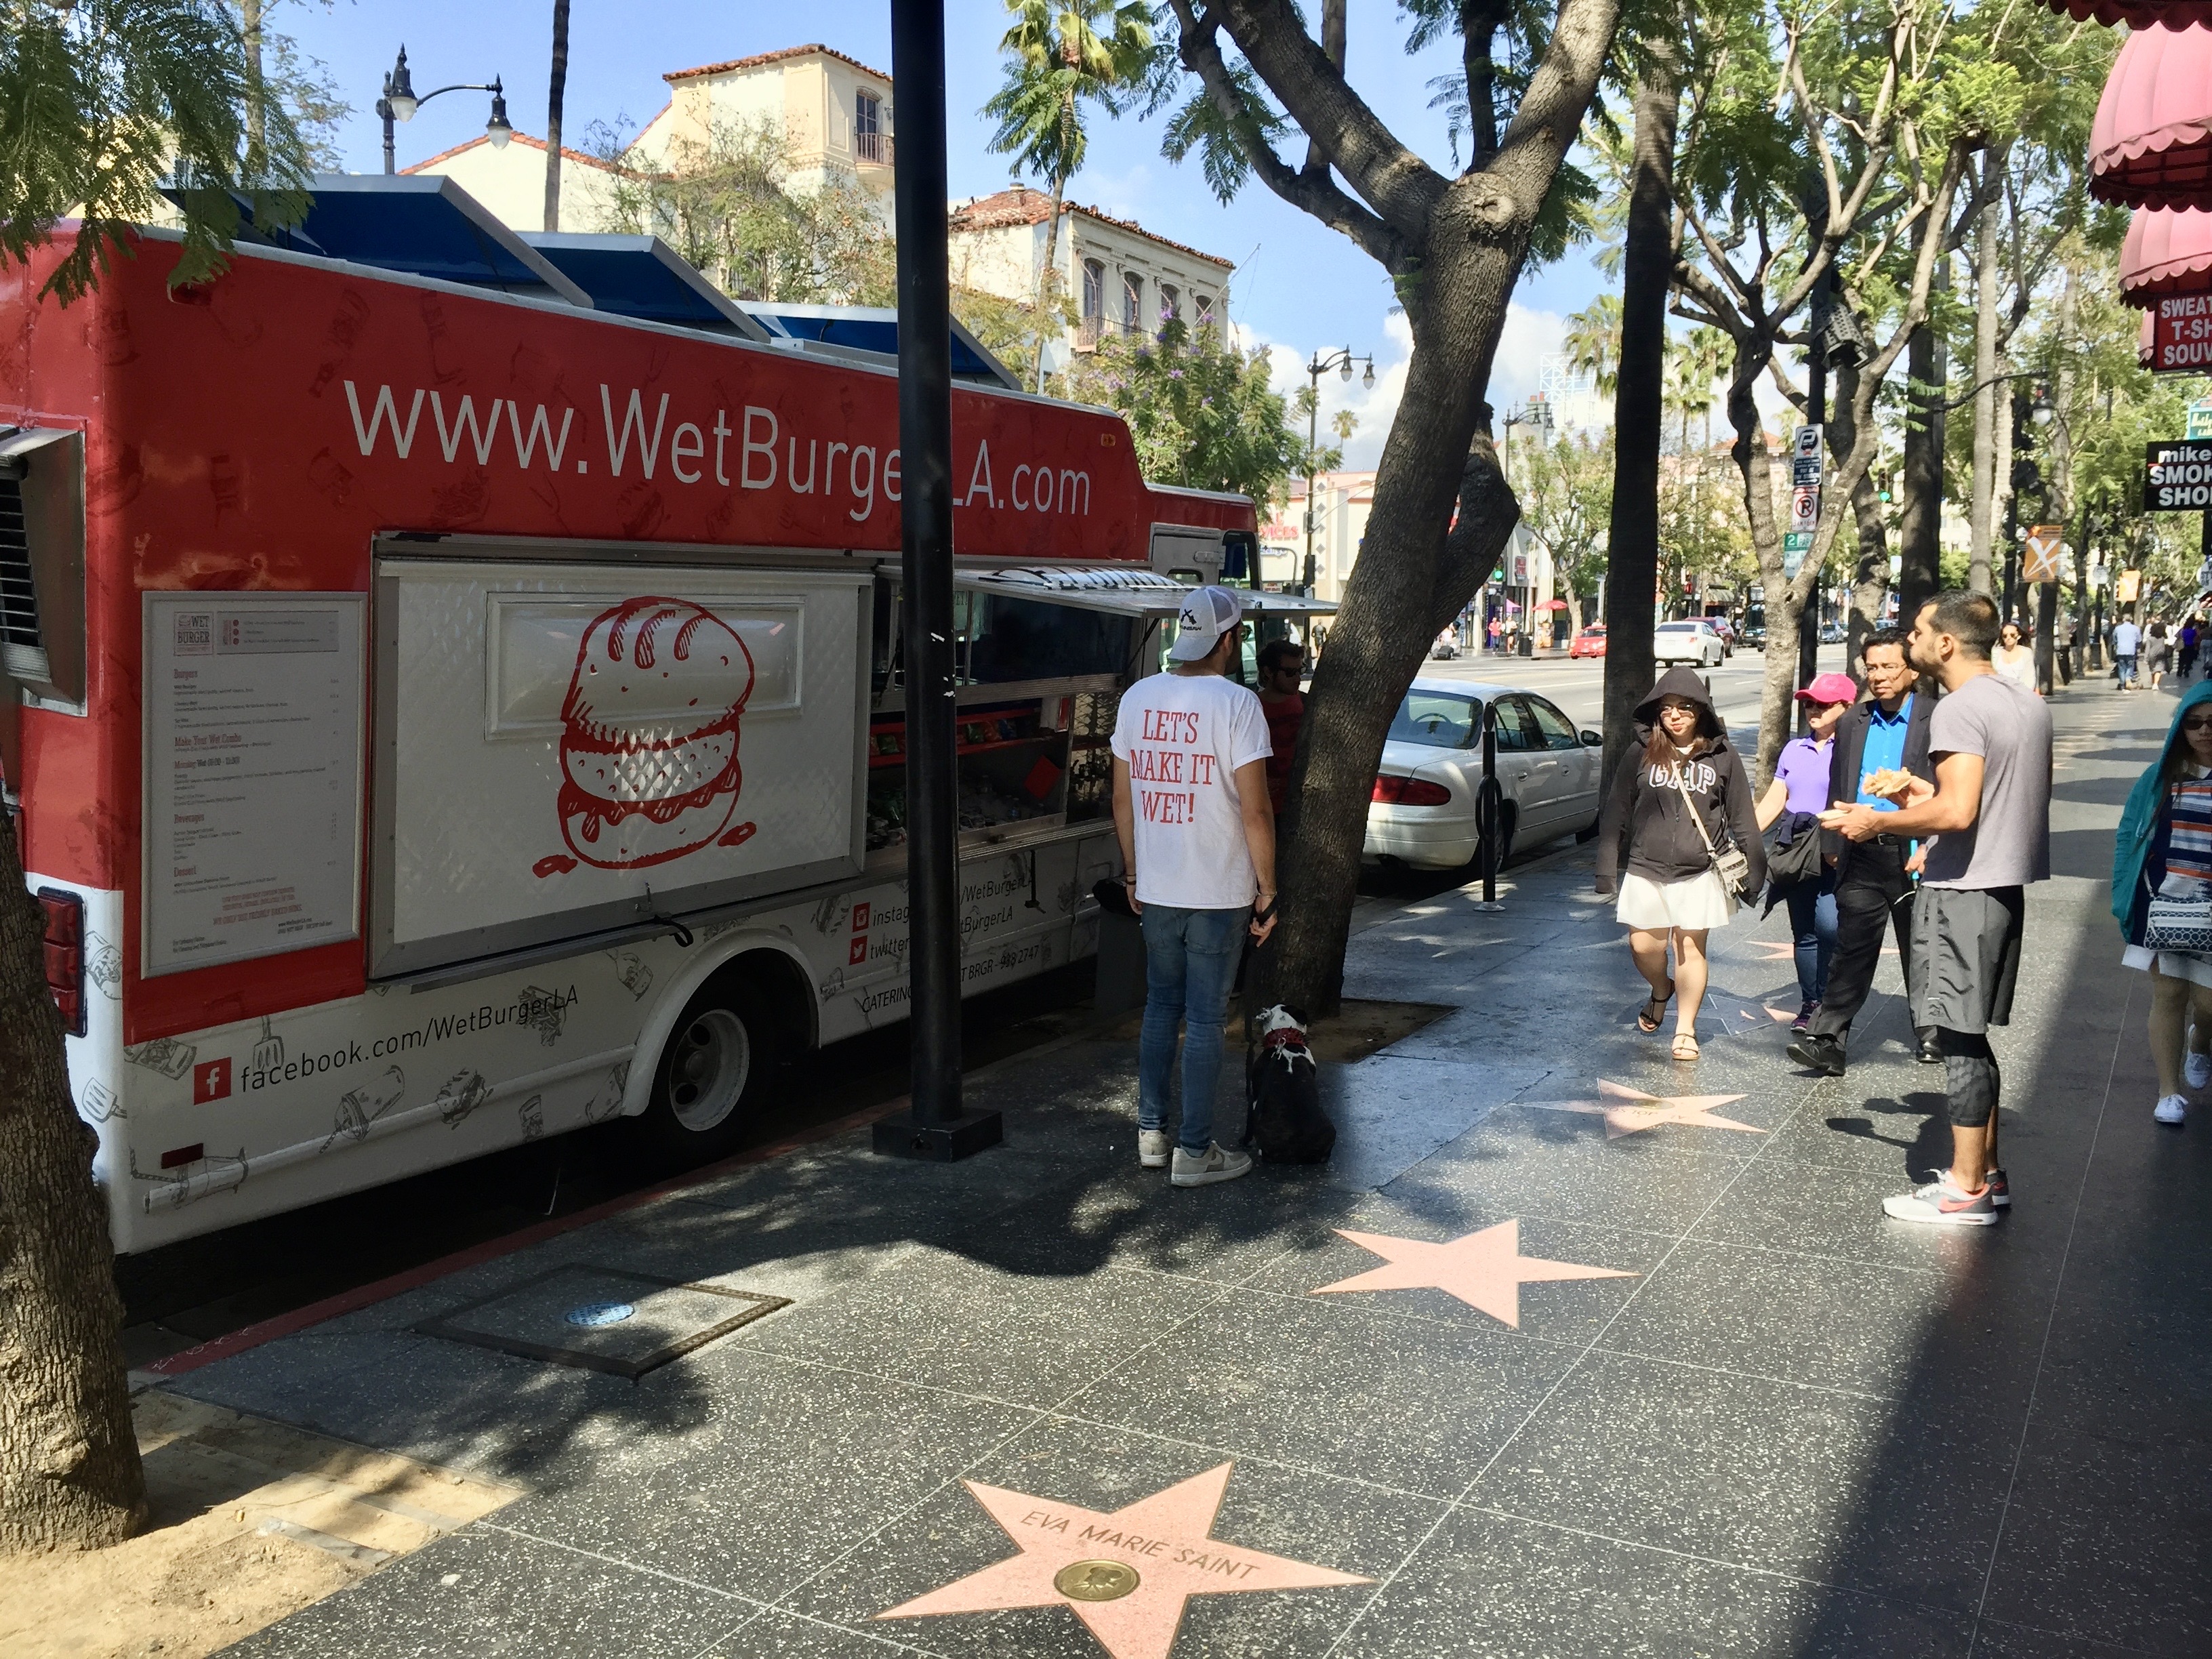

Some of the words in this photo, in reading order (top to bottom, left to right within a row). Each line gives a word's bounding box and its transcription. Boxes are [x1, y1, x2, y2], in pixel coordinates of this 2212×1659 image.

[344, 380, 1090, 521] www.WetBurgeA.com
[2158, 486, 2212, 506] SHO
[177, 631, 210, 644] BURGER
[1142, 709, 1200, 744] LET'S
[1130, 749, 1183, 784] MAKE
[1189, 754, 1215, 785] IT
[1141, 790, 1195, 824] WET!
[241, 984, 579, 1093] facebook.com/WetBurgerLA
[1020, 1510, 1071, 1533] EVA
[1078, 1523, 1168, 1559] MARIE
[1173, 1548, 1261, 1581] SAINT
